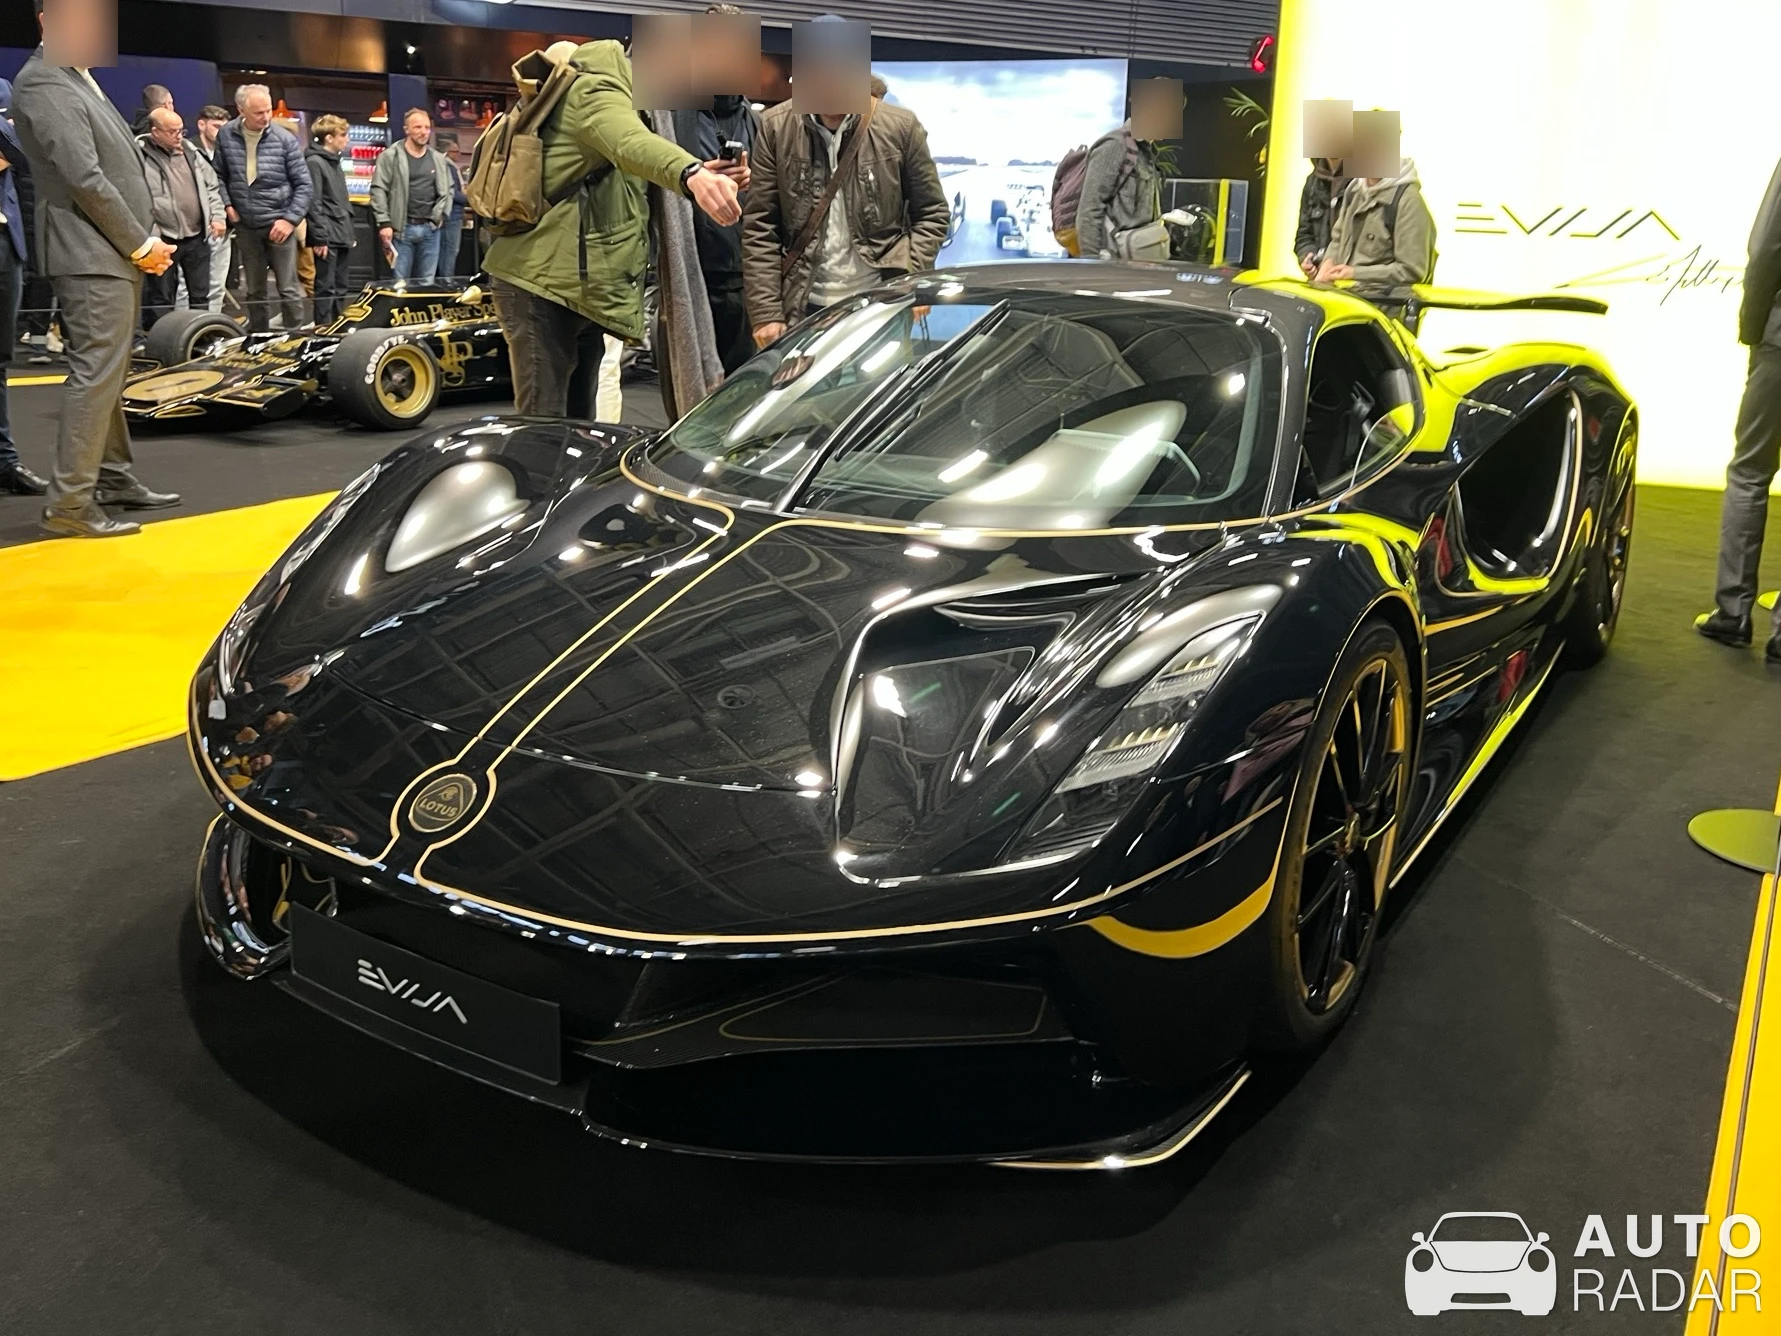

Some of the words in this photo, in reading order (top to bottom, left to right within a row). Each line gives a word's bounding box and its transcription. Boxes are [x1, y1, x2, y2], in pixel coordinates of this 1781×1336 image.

[390, 306, 429, 326] John
[428, 303, 472, 323] Player
[364, 335, 409, 385] GOODYE
[419, 798, 458, 818] LOTUS
[357, 959, 468, 1025] EVIJA
